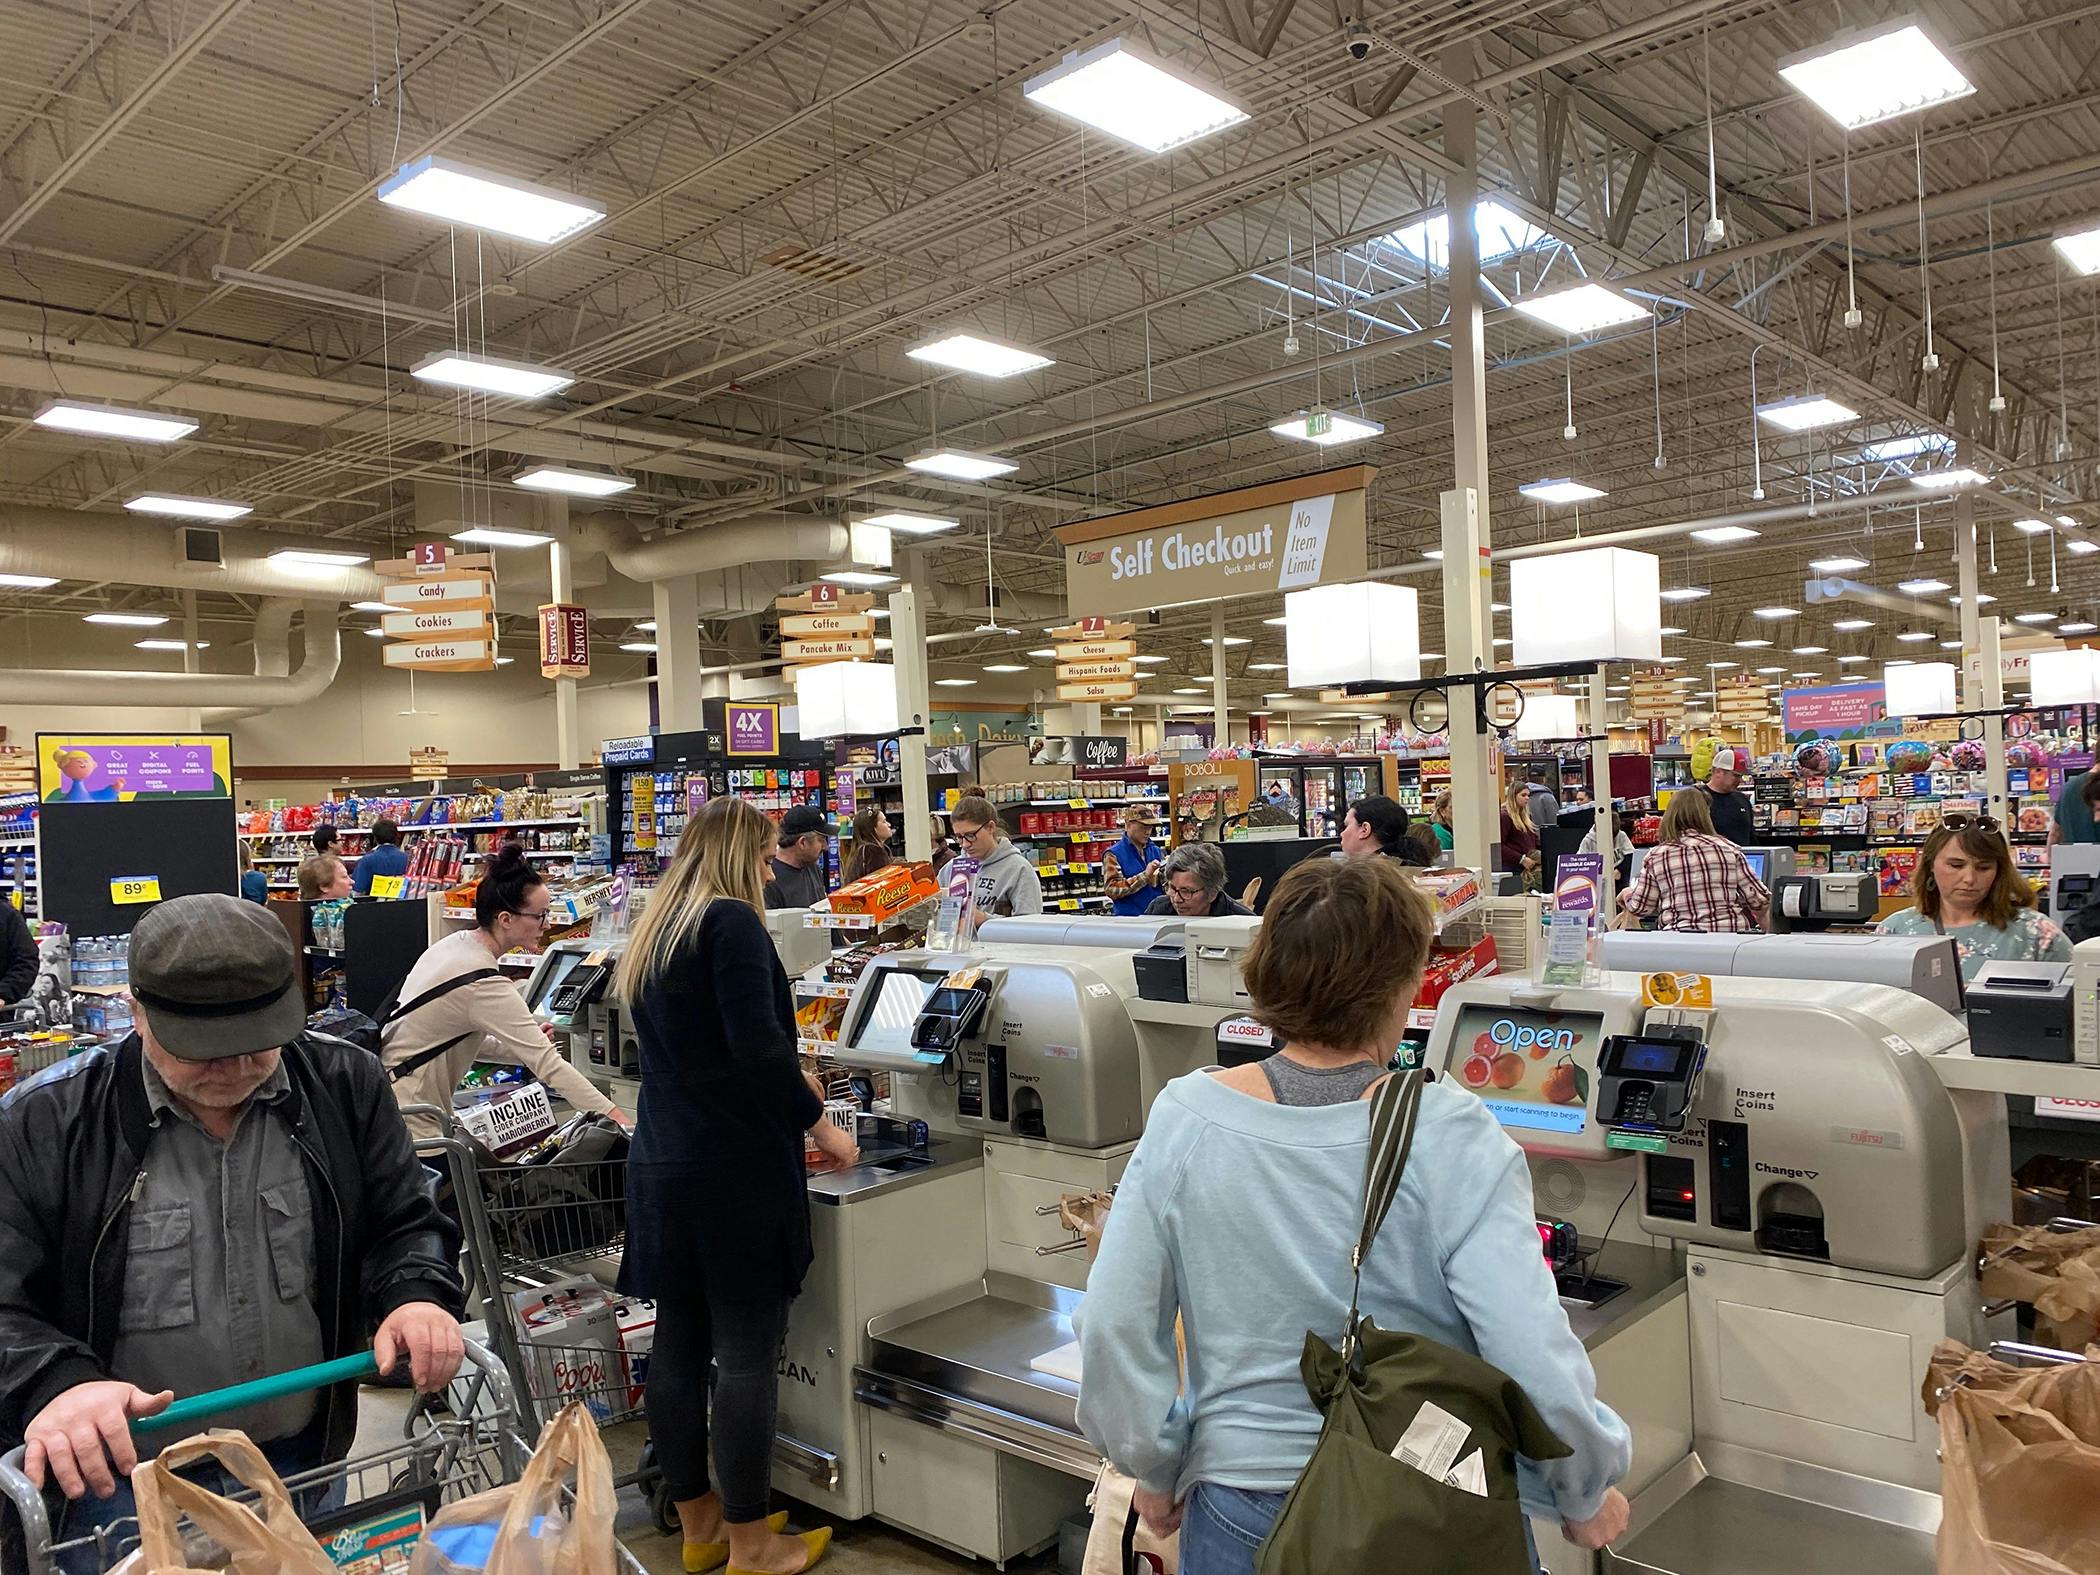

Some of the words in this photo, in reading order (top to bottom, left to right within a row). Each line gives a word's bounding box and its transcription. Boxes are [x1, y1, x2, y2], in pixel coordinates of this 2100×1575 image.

[1295, 511, 1311, 529] No
[1291, 534, 1317, 552] Item
[425, 545, 434, 563] 5
[1110, 538, 1154, 581] Self
[1161, 523, 1273, 571] Checkout
[1224, 562, 1242, 577] Quick
[1243, 560, 1256, 573] and
[1258, 558, 1275, 572] easy!
[1287, 553, 1317, 576] Limit
[418, 584, 446, 597] Candy
[820, 586, 829, 601] 6
[415, 616, 452, 629] Cookies
[812, 618, 840, 631] Coffee
[1089, 617, 1097, 631] 7
[547, 611, 558, 663] SERVICE
[571, 612, 586, 663] SERVICE
[415, 647, 455, 659] Crackers
[800, 643, 833, 656] Pancake
[836, 642, 853, 654] Mix
[1082, 644, 1106, 655] Cheese
[1067, 665, 1098, 677] Hispanic
[1100, 664, 1122, 675] Foods
[1653, 667, 1661, 675] 10
[1739, 675, 1746, 683] 11
[1086, 686, 1105, 696] Salsa
[736, 712, 763, 732] 4X
[608, 739, 644, 751] Reloadable
[709, 736, 720, 744] 2X
[605, 751, 628, 763] Prepaid
[629, 749, 649, 760] Cards
[1086, 740, 1119, 765] Coffee
[838, 775, 852, 785] 4X
[690, 785, 704, 795] 4X
[979, 878, 995, 890] EE
[1562, 896, 1589, 908] rewards
[1003, 1021, 1022, 1029] Insert
[1227, 1025, 1264, 1036] CLOSED
[1002, 1028, 1021, 1036] Coins
[1489, 1018, 1574, 1051] Open
[968, 1050, 986, 1058] Insert
[1009, 1072, 1033, 1082] Change
[1736, 1087, 1776, 1100] Insert
[489, 1092, 545, 1126] INCLINE
[1504, 1104, 1519, 1113] start
[1519, 1107, 1549, 1118] scanning
[1735, 1098, 1775, 1111] Coins
[494, 1120, 516, 1133] CIDER
[514, 1107, 547, 1126] COMPANY
[832, 1110, 853, 1126] INE
[498, 1115, 551, 1144] MARIONBERRY
[1669, 1135, 1704, 1147] Coins
[1755, 1162, 1804, 1179] Change
